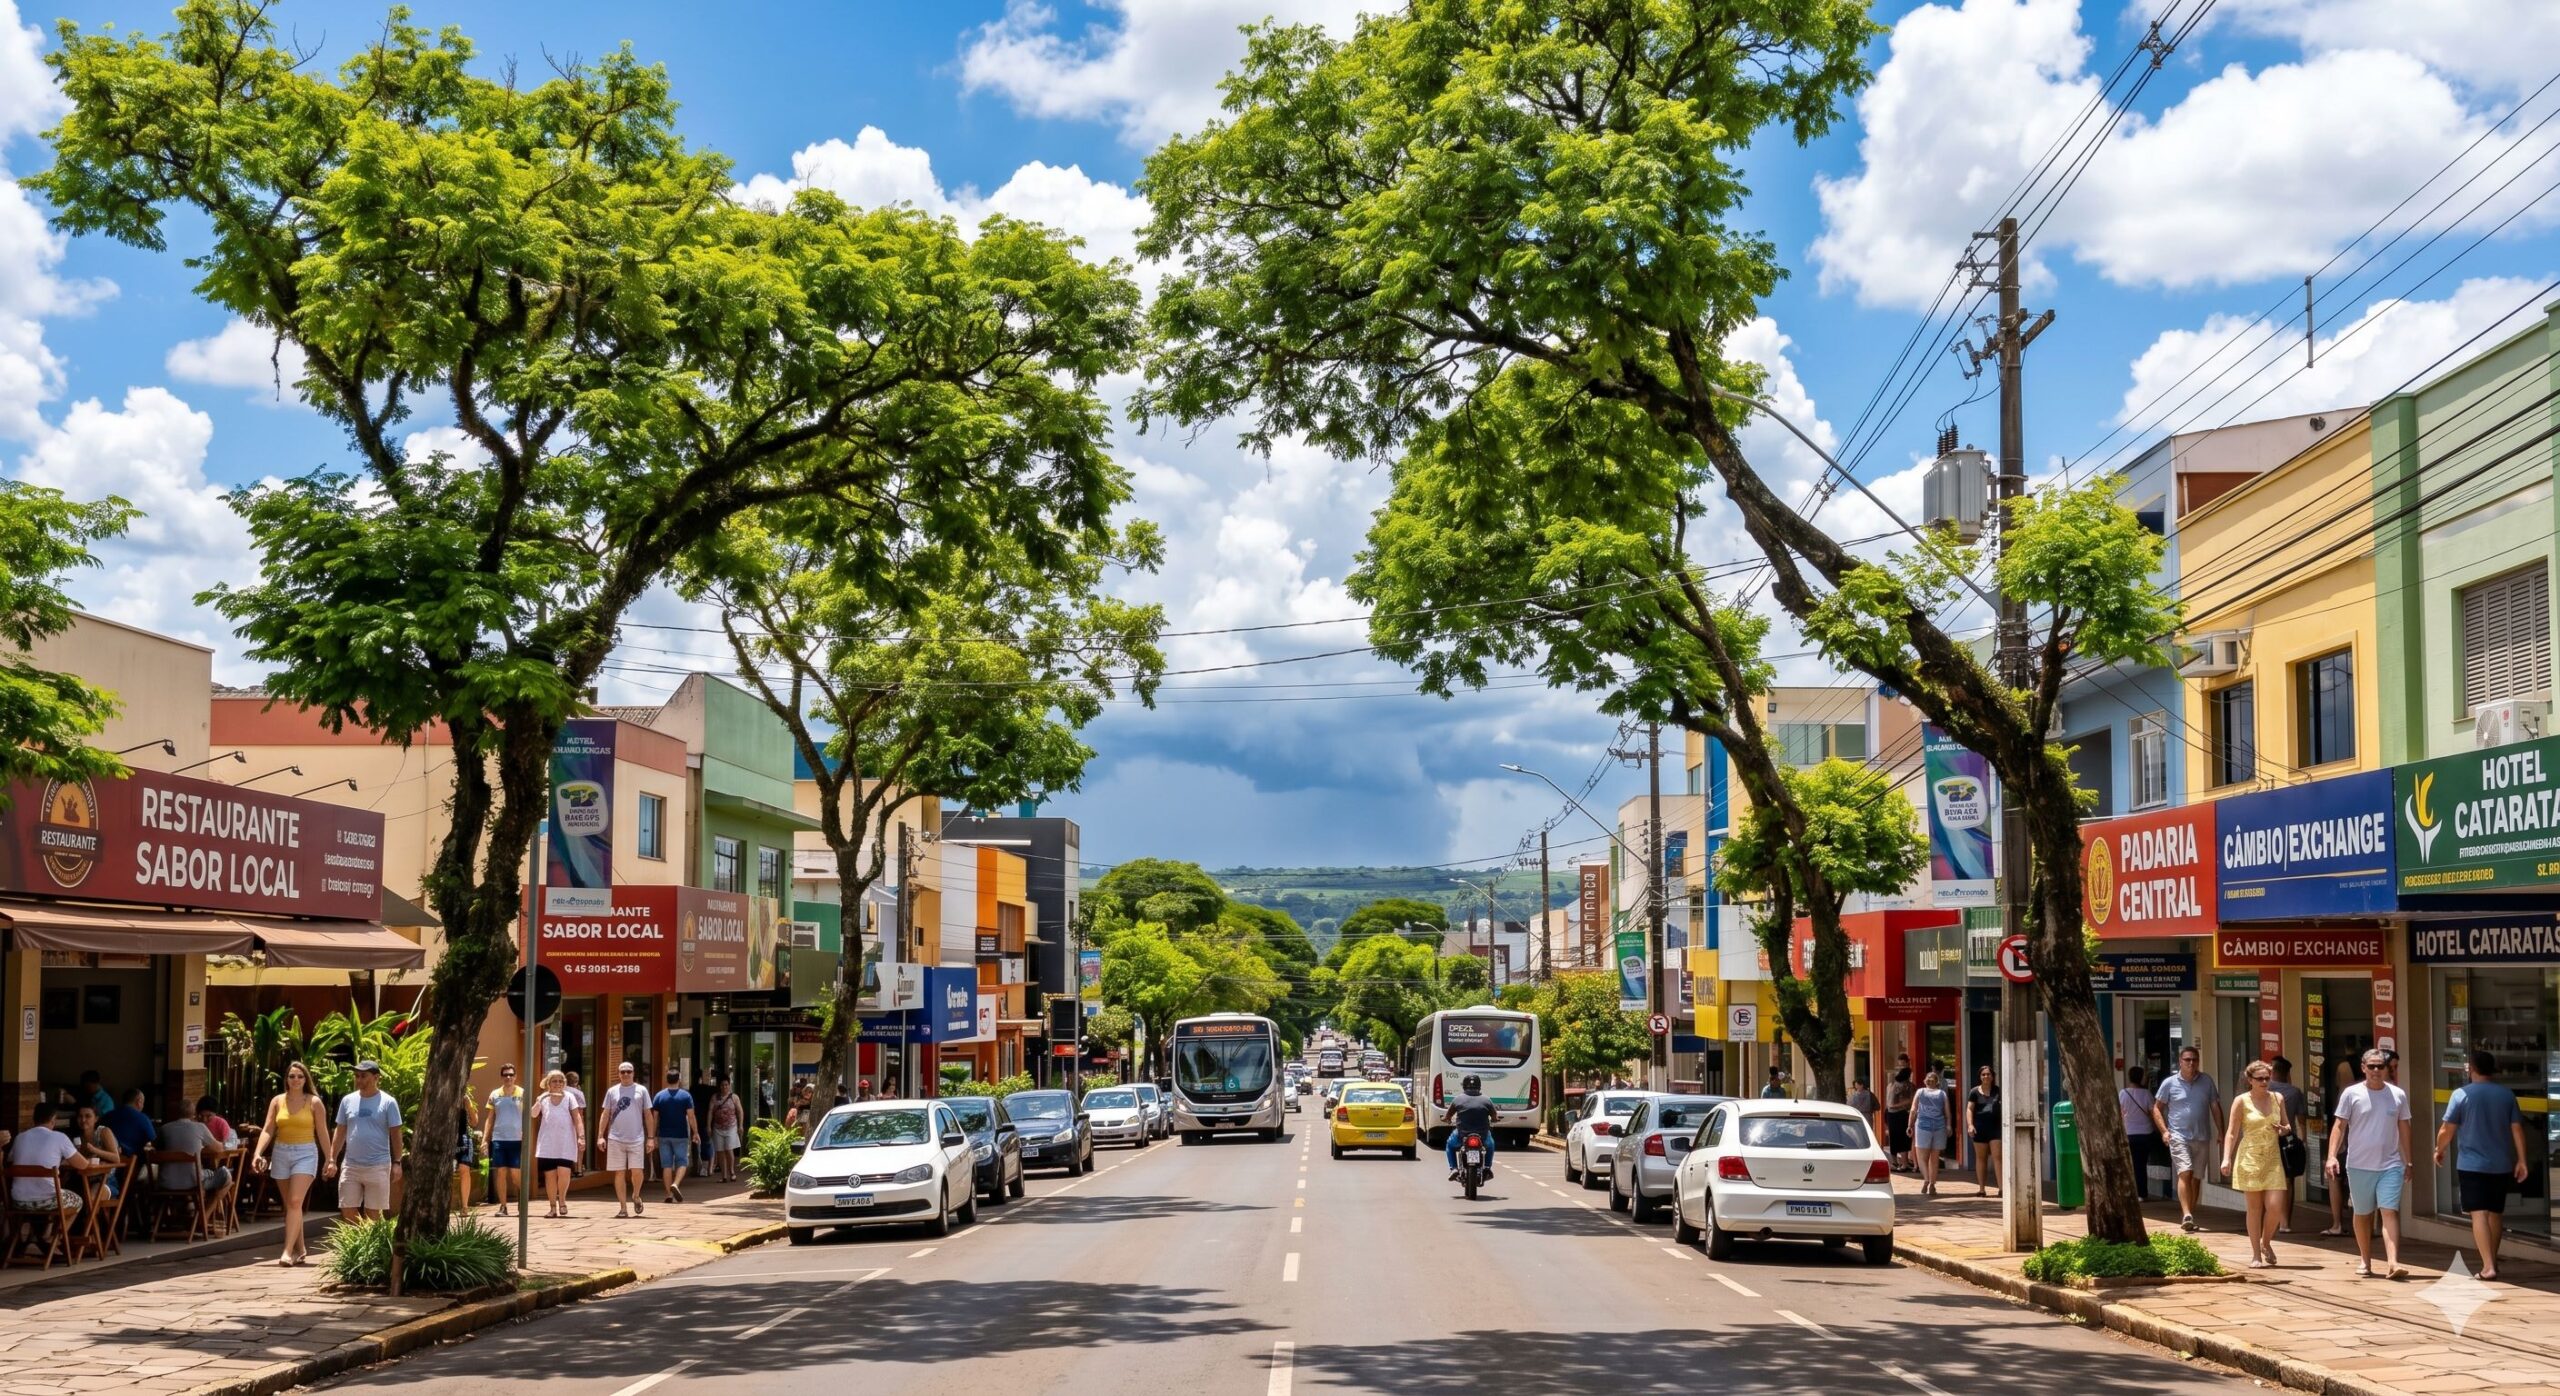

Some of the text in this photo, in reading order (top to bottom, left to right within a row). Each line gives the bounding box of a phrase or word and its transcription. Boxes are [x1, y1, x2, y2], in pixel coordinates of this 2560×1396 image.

[2482, 750, 2546, 790] HOTEL
[142, 787, 300, 848] RESTAURANTE
[41, 830, 97, 851] RESTAURANTE
[2120, 823, 2199, 873] PADARIA
[136, 842, 222, 891] SABOR
[229, 854, 300, 899] LOCAL
[2119, 875, 2201, 922] CENTRAL
[543, 923, 664, 939] SABOR LOCAL
[698, 916, 745, 942] SABOR LOCAL
[2416, 930, 2465, 956] HOTEL
[575, 965, 587, 973] 45
